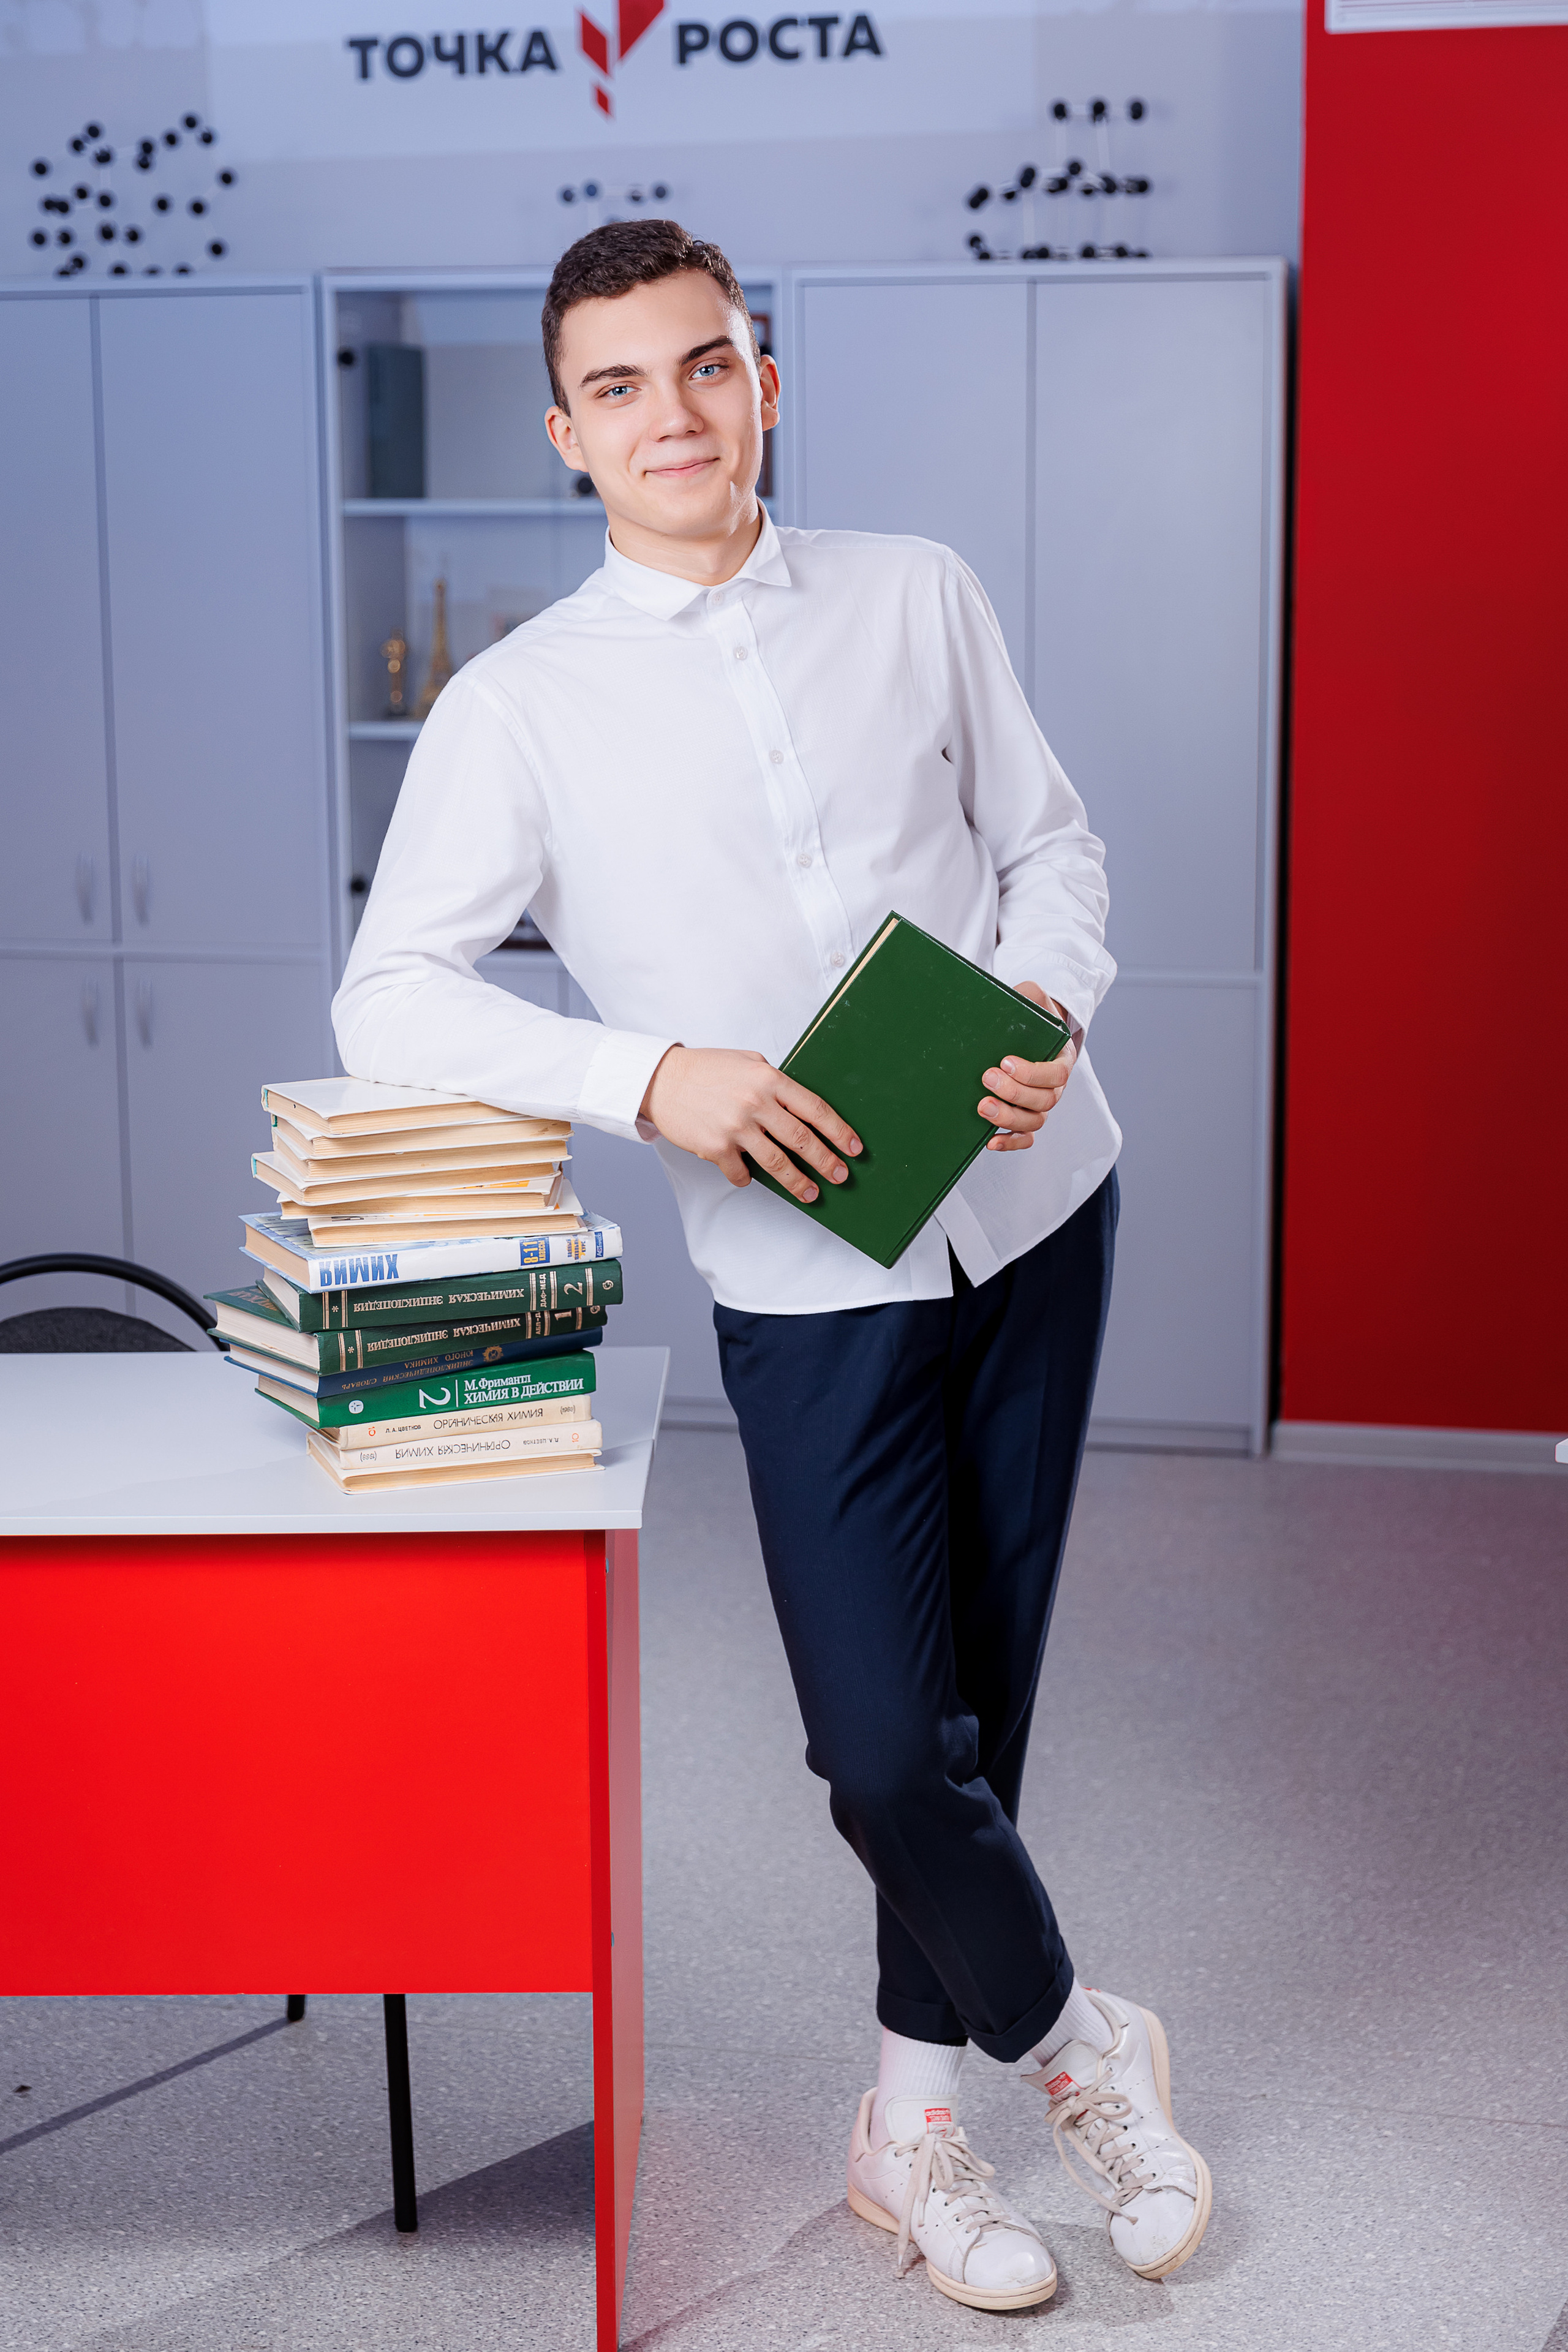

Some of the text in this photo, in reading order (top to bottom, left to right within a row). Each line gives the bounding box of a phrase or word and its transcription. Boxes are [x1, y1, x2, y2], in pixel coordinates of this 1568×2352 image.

[349, 15, 880, 79] ТОЧКА РОСТА
[522, 1241, 538, 1264] 8-11
[318, 1254, 399, 1286] ХИМИЯ
[564, 1282, 582, 1295] 2
[353, 1289, 524, 1313] ХИМИЧЕСКАЯ ЭНЦИКЛОПЕДИЯ
[554, 1310, 572, 1321] 1
[367, 1317, 521, 1352] ХИМИЧЕСКАЯ ЭНЦИКЛОПЕДИЯ
[404, 1349, 473, 1369] ЮНОГО ХИМИКА
[342, 1360, 473, 1390] ЭНЦИКЛОПЕДИЧЕСКИЙ СЛОВАРЬ
[419, 1387, 451, 1409] 2
[464, 1378, 584, 1404] ХИМИЯ В ДЕЙСТВИИ
[434, 1408, 543, 1430] ОРГАНИЧЕСКАЯ ХИМИЯ
[395, 1439, 511, 1459] ОРГАНИЧЕСКАЯ ХИМИЯ
